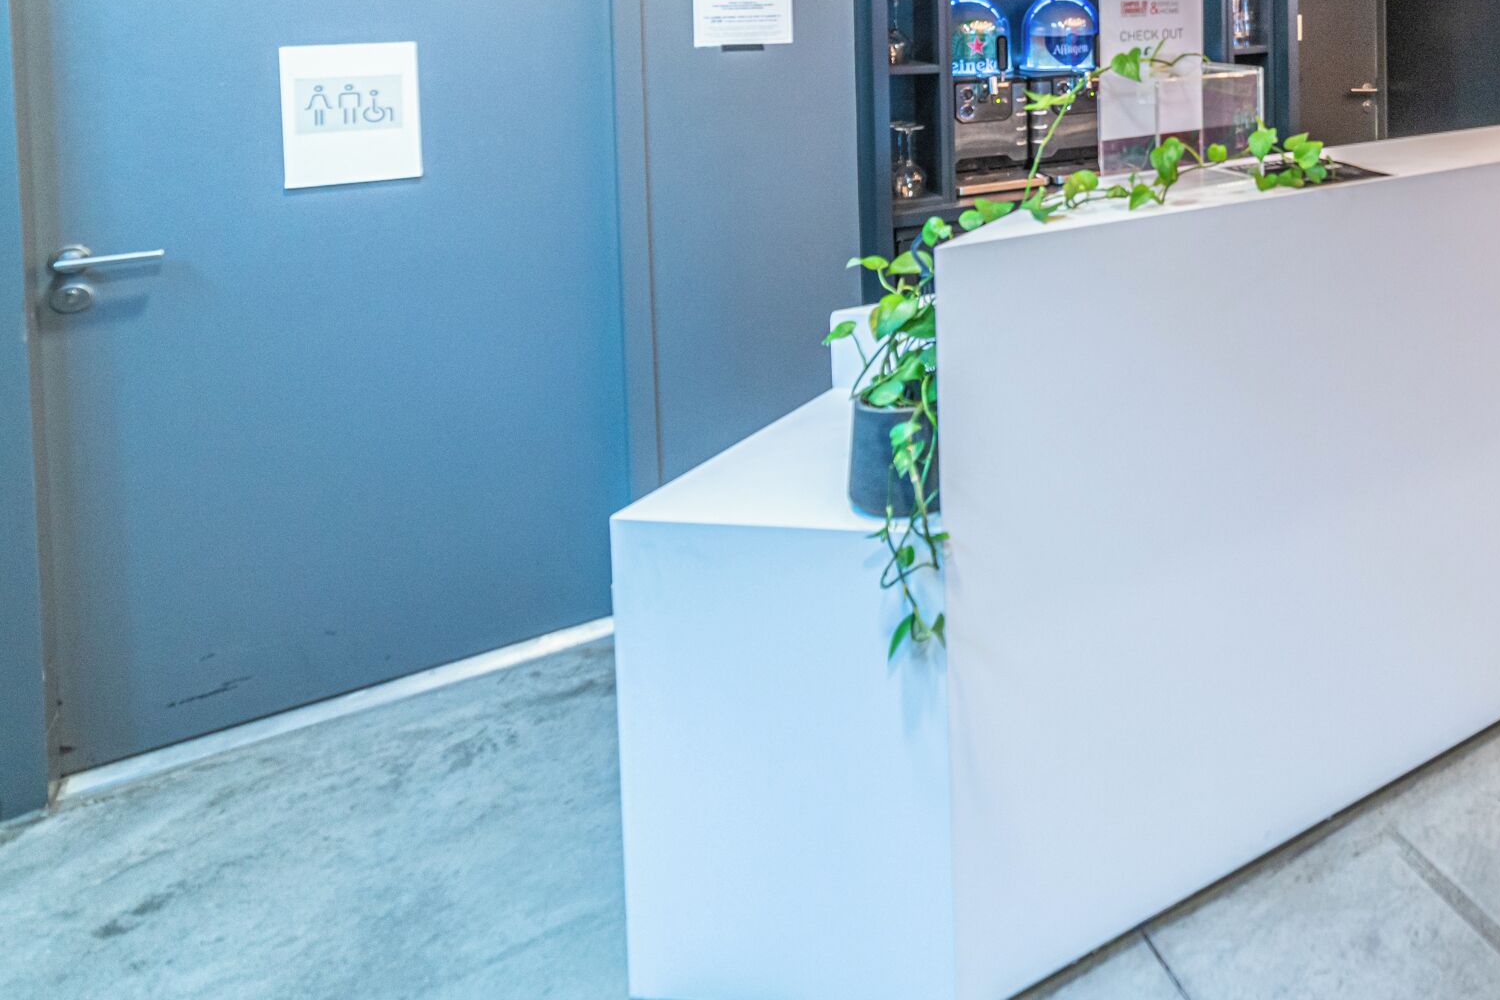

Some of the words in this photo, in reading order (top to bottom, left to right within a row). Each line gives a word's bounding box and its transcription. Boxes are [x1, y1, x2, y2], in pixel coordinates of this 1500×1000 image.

[1119, 29, 1159, 43] CHECK
[1162, 27, 1184, 41] OUT
[952, 57, 999, 75] einek
